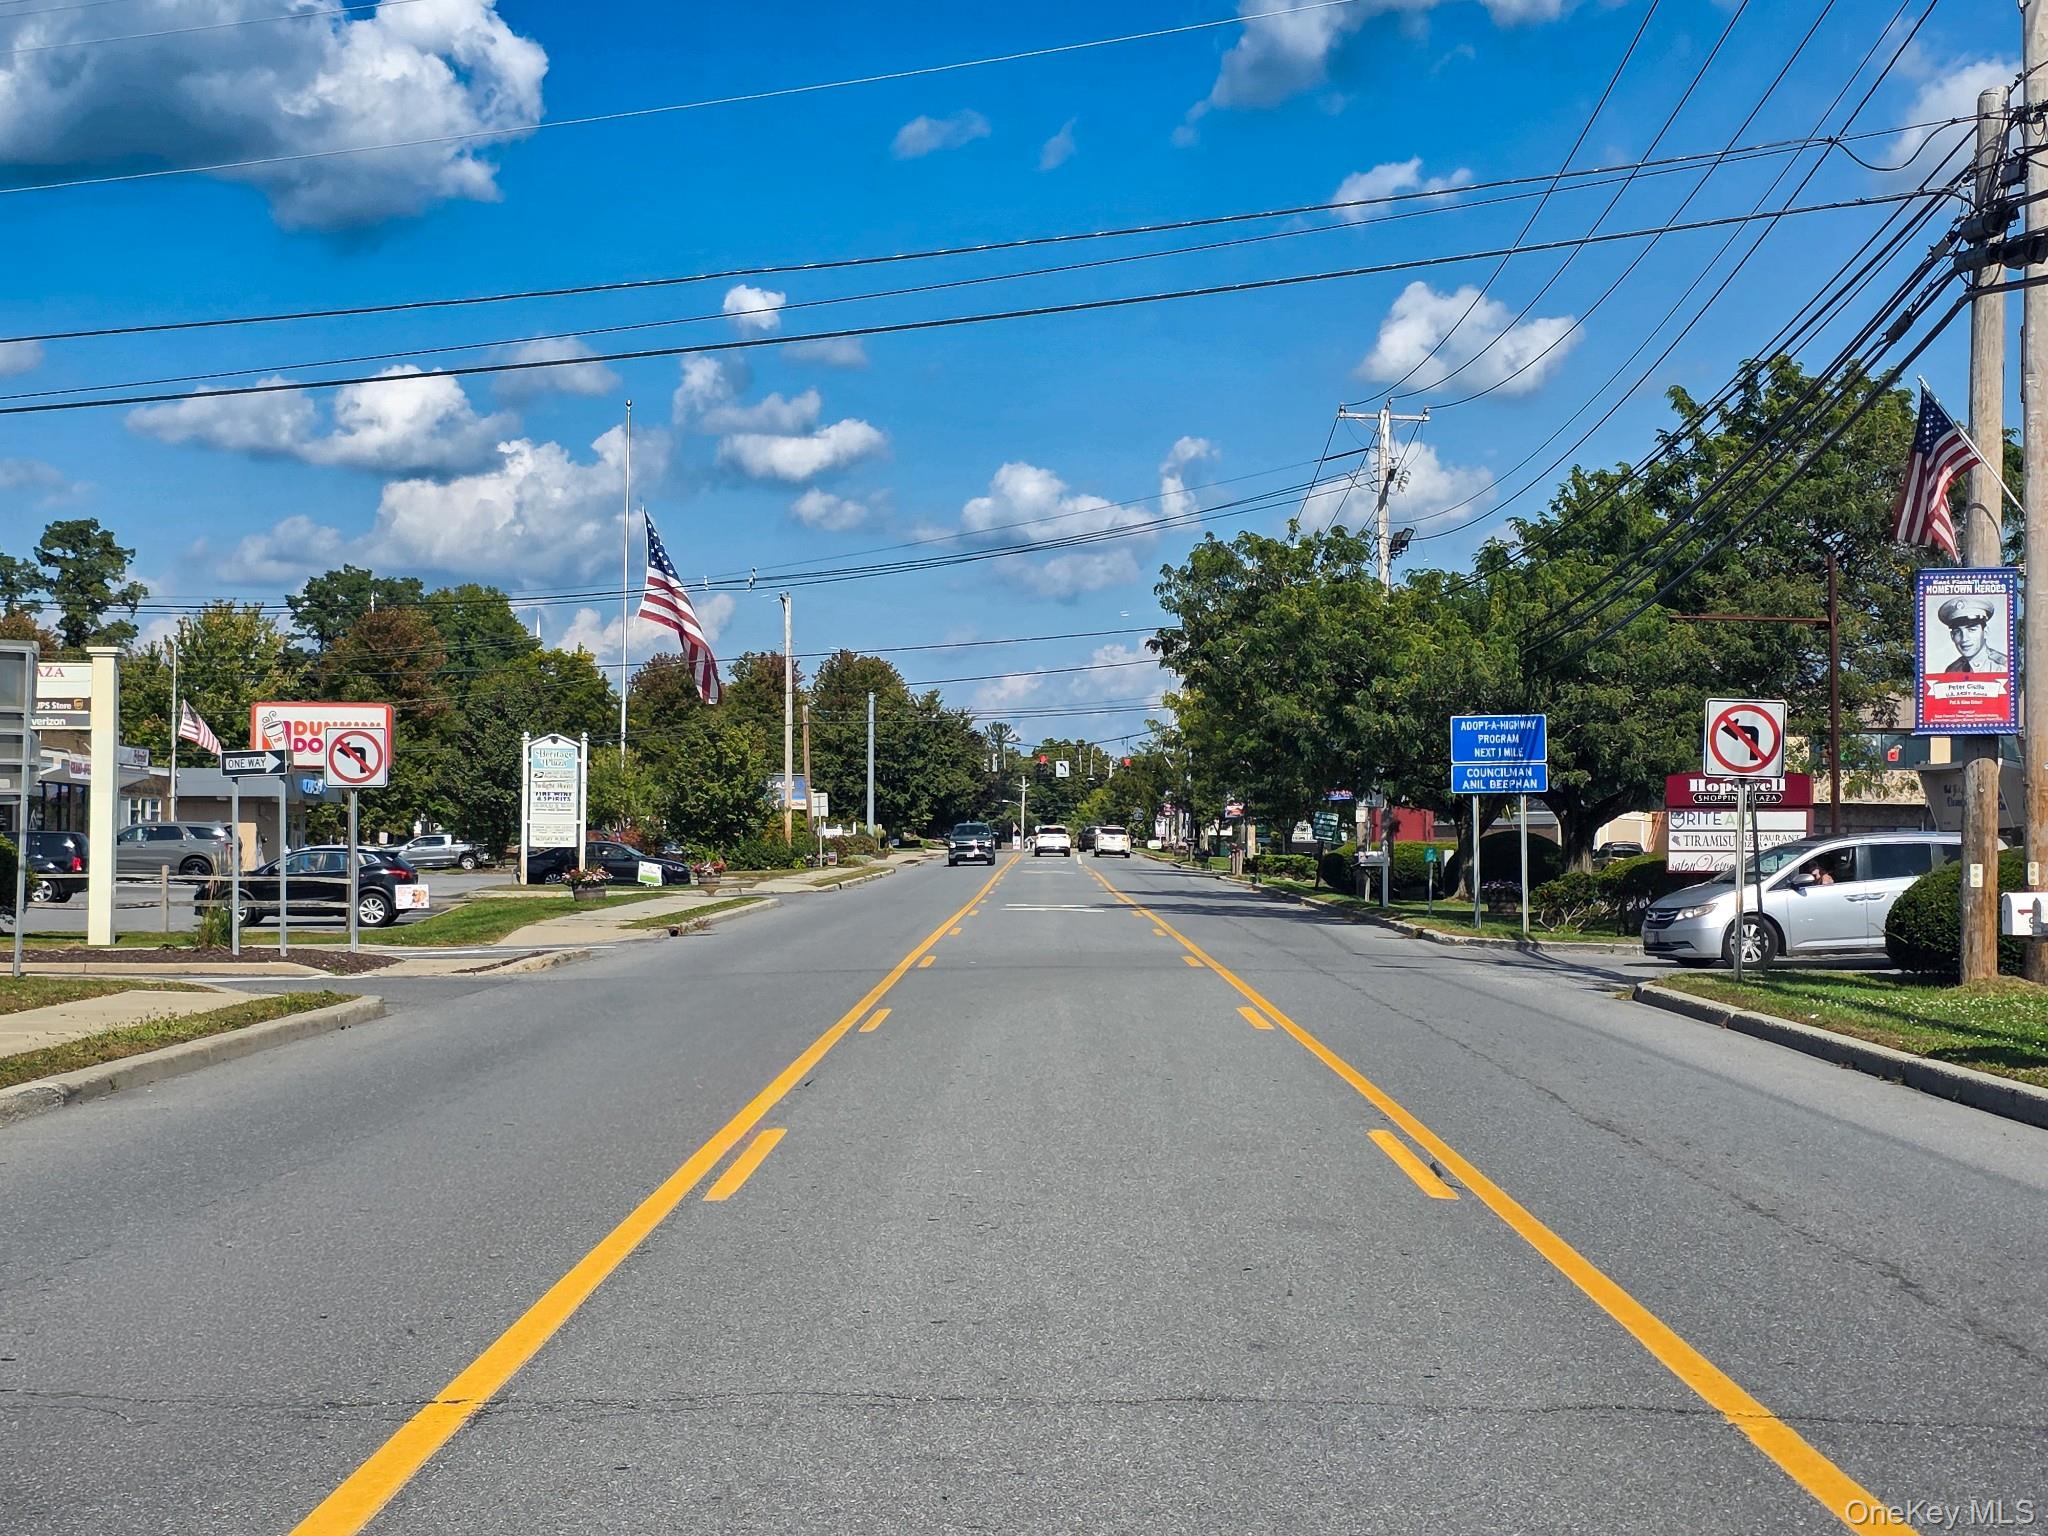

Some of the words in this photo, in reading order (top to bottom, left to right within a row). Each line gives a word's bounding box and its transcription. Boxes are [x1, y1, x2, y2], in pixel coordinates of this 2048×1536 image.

[1926, 584, 1973, 594] HOMETOWN
[1974, 583, 2007, 593] HEROES
[37, 666, 65, 678] AZA
[51, 701, 72, 710] Store
[31, 716, 66, 726] verizon
[1460, 720, 1537, 731] ADOPT-A-HIGHWAY
[1477, 734, 1520, 744] PROGRAM
[1474, 747, 1496, 757] NEXT
[1503, 747, 1524, 757] MILE
[228, 758, 246, 768] ONE
[247, 757, 266, 768] WAY
[1466, 767, 1533, 778] COUNCILMAN
[1462, 779, 1487, 790] ANIL
[1686, 812, 1722, 826] RITE
[1724, 812, 1752, 826] AD
[1683, 834, 1736, 847] TIRAMISU
